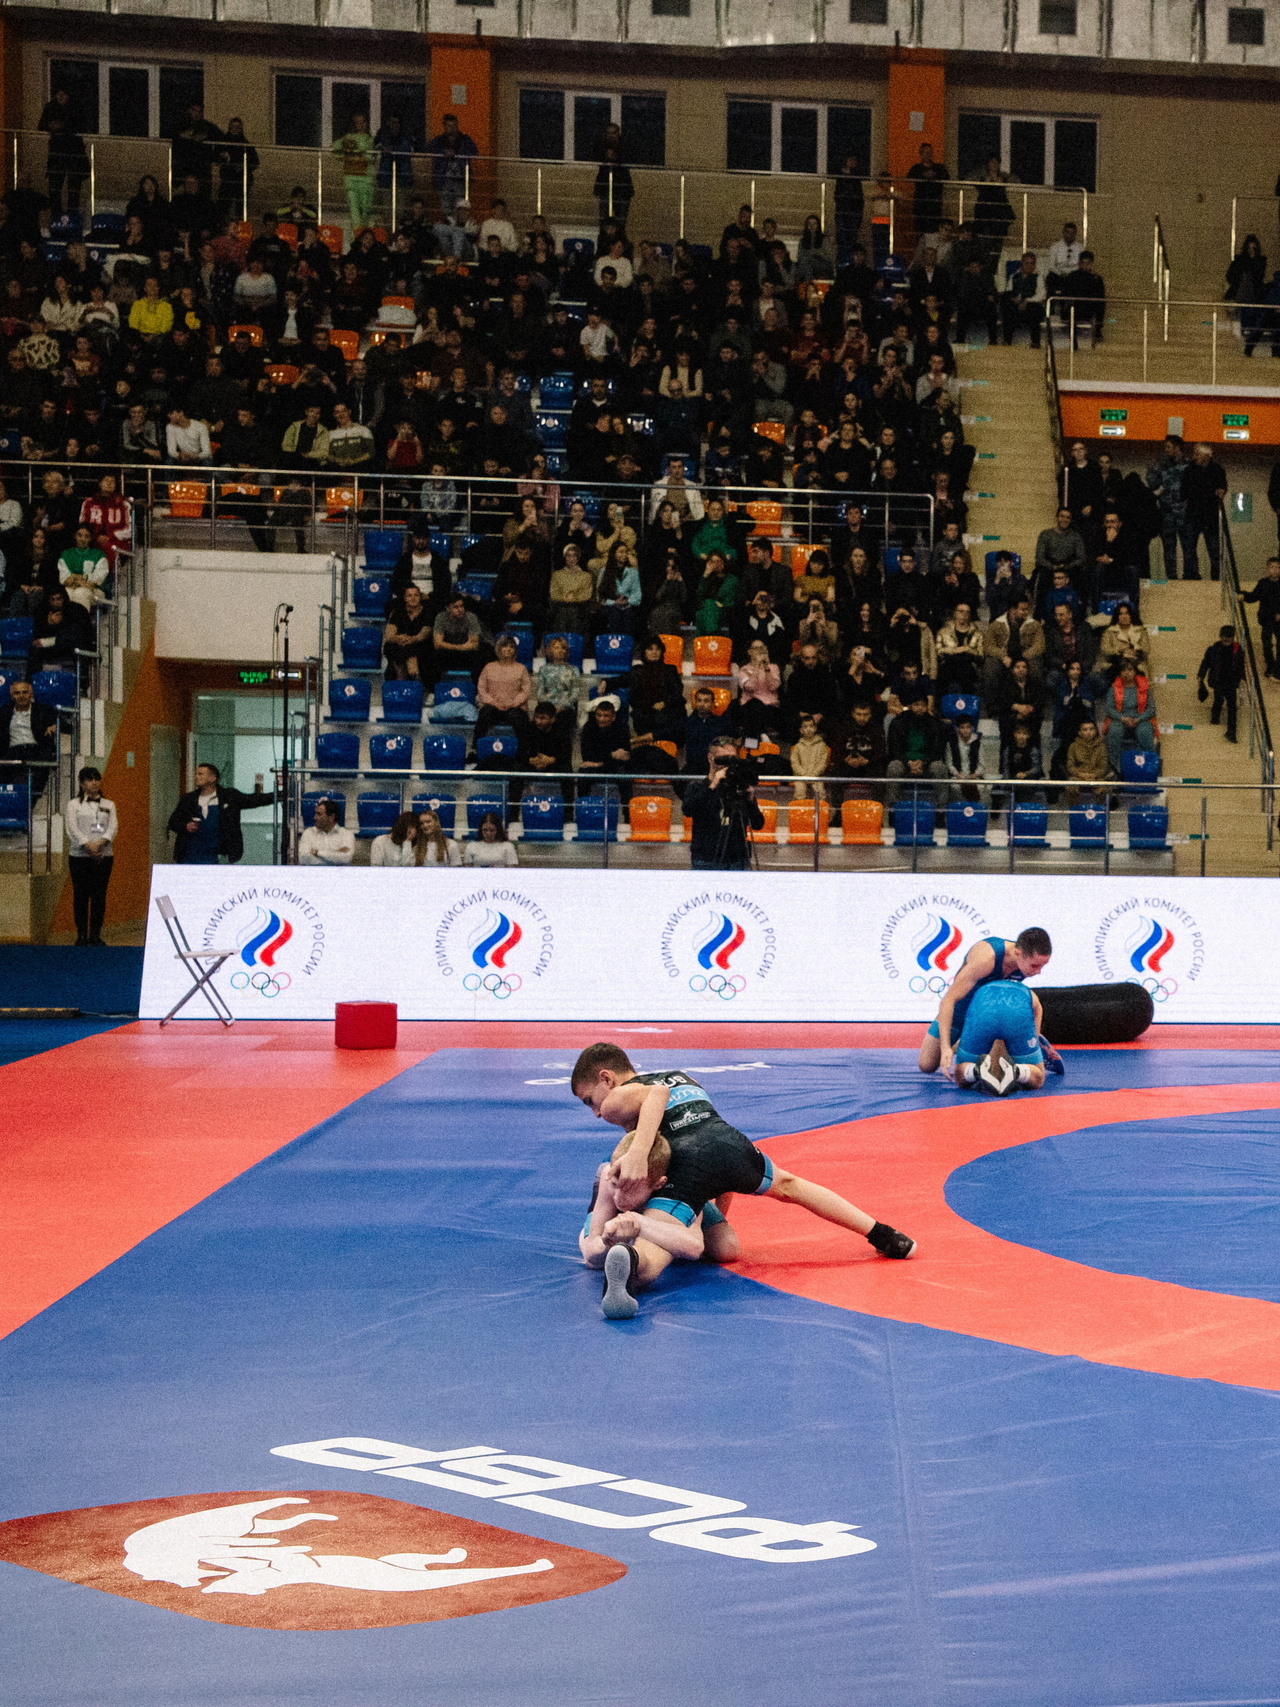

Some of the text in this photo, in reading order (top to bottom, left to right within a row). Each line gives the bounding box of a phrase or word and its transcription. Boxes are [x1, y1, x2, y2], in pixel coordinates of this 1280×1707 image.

[203, 887, 325, 976] ЛМПИЙСКИЙ КОМИТЕТ РОССИИ
[435, 888, 554, 977] ОЛИМПИЙСКИЙ КОМИТЕТ РОССИИ
[661, 891, 776, 979] ОЛИМПИЙСКИЙ КОМИТЕТ РОССИИ
[880, 894, 986, 979] ОЛИМПИЙСКИЙ КОМИТЕТ
[1095, 896, 1205, 981] ОЛИМПИЙСКИЙ КОМИТЕТ РОССИИ
[669, 1088, 705, 1102] UTYZ
